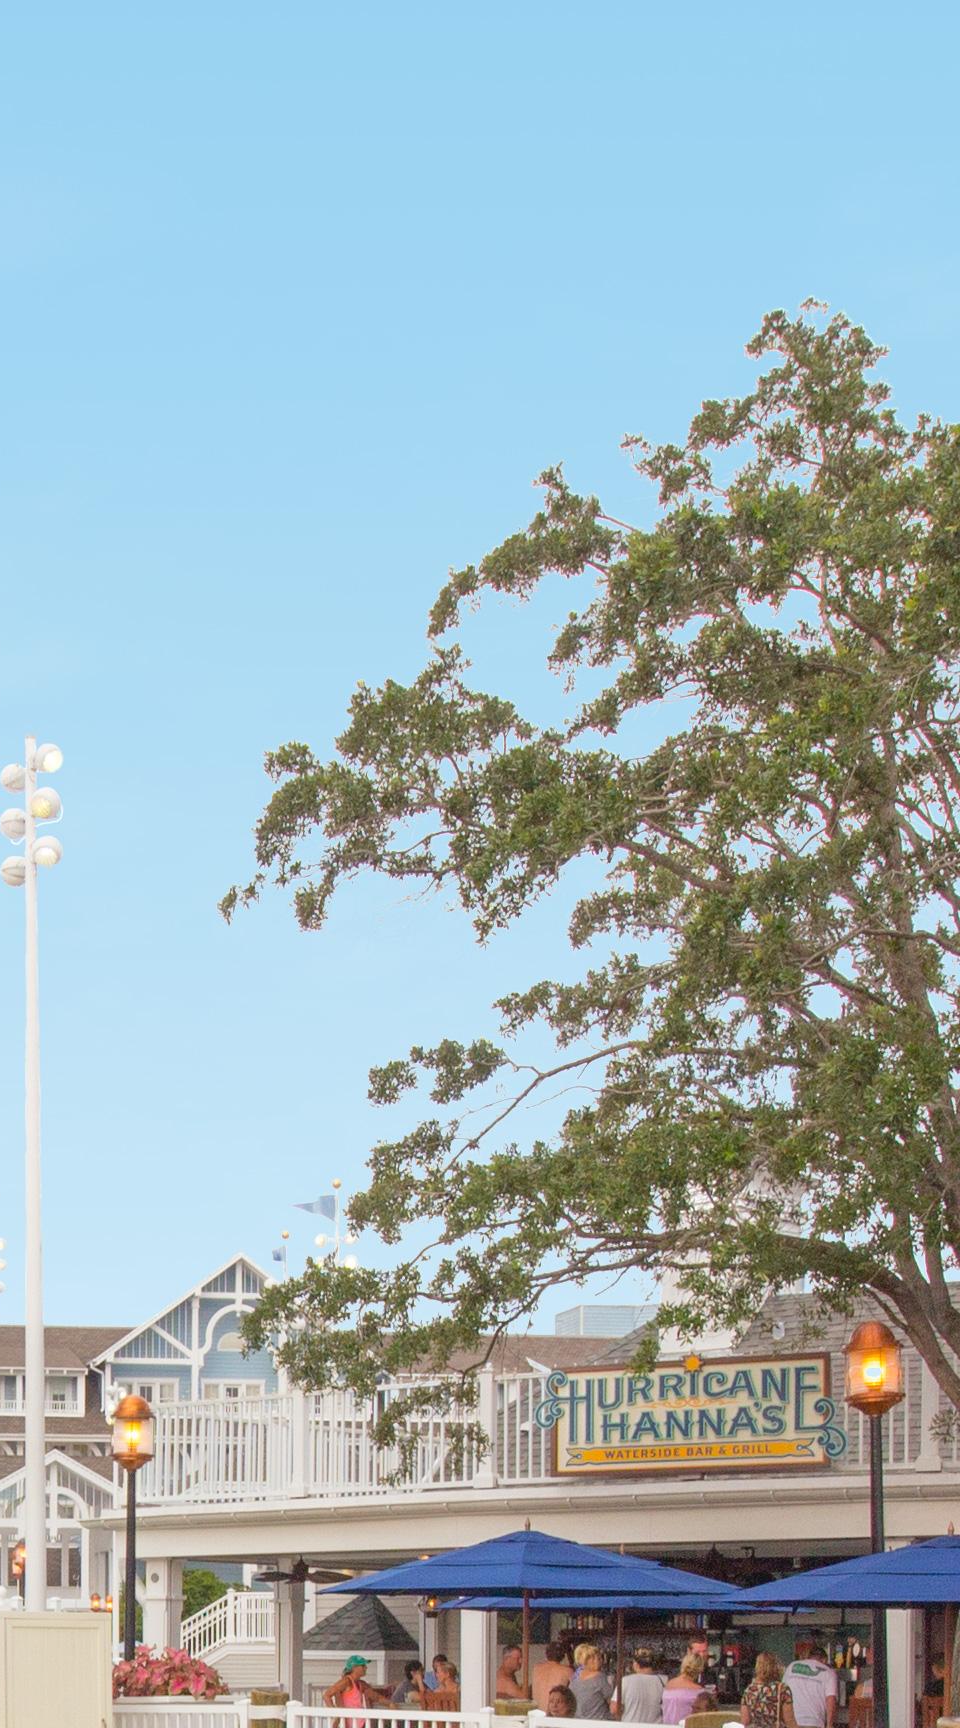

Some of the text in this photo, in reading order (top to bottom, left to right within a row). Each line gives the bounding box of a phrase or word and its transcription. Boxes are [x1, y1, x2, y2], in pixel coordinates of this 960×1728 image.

[548, 1365, 834, 1446] HURRICANE
[601, 1402, 787, 1443] HANNA'S
[604, 1443, 772, 1459] WATERSIDE BAR & GRILL
